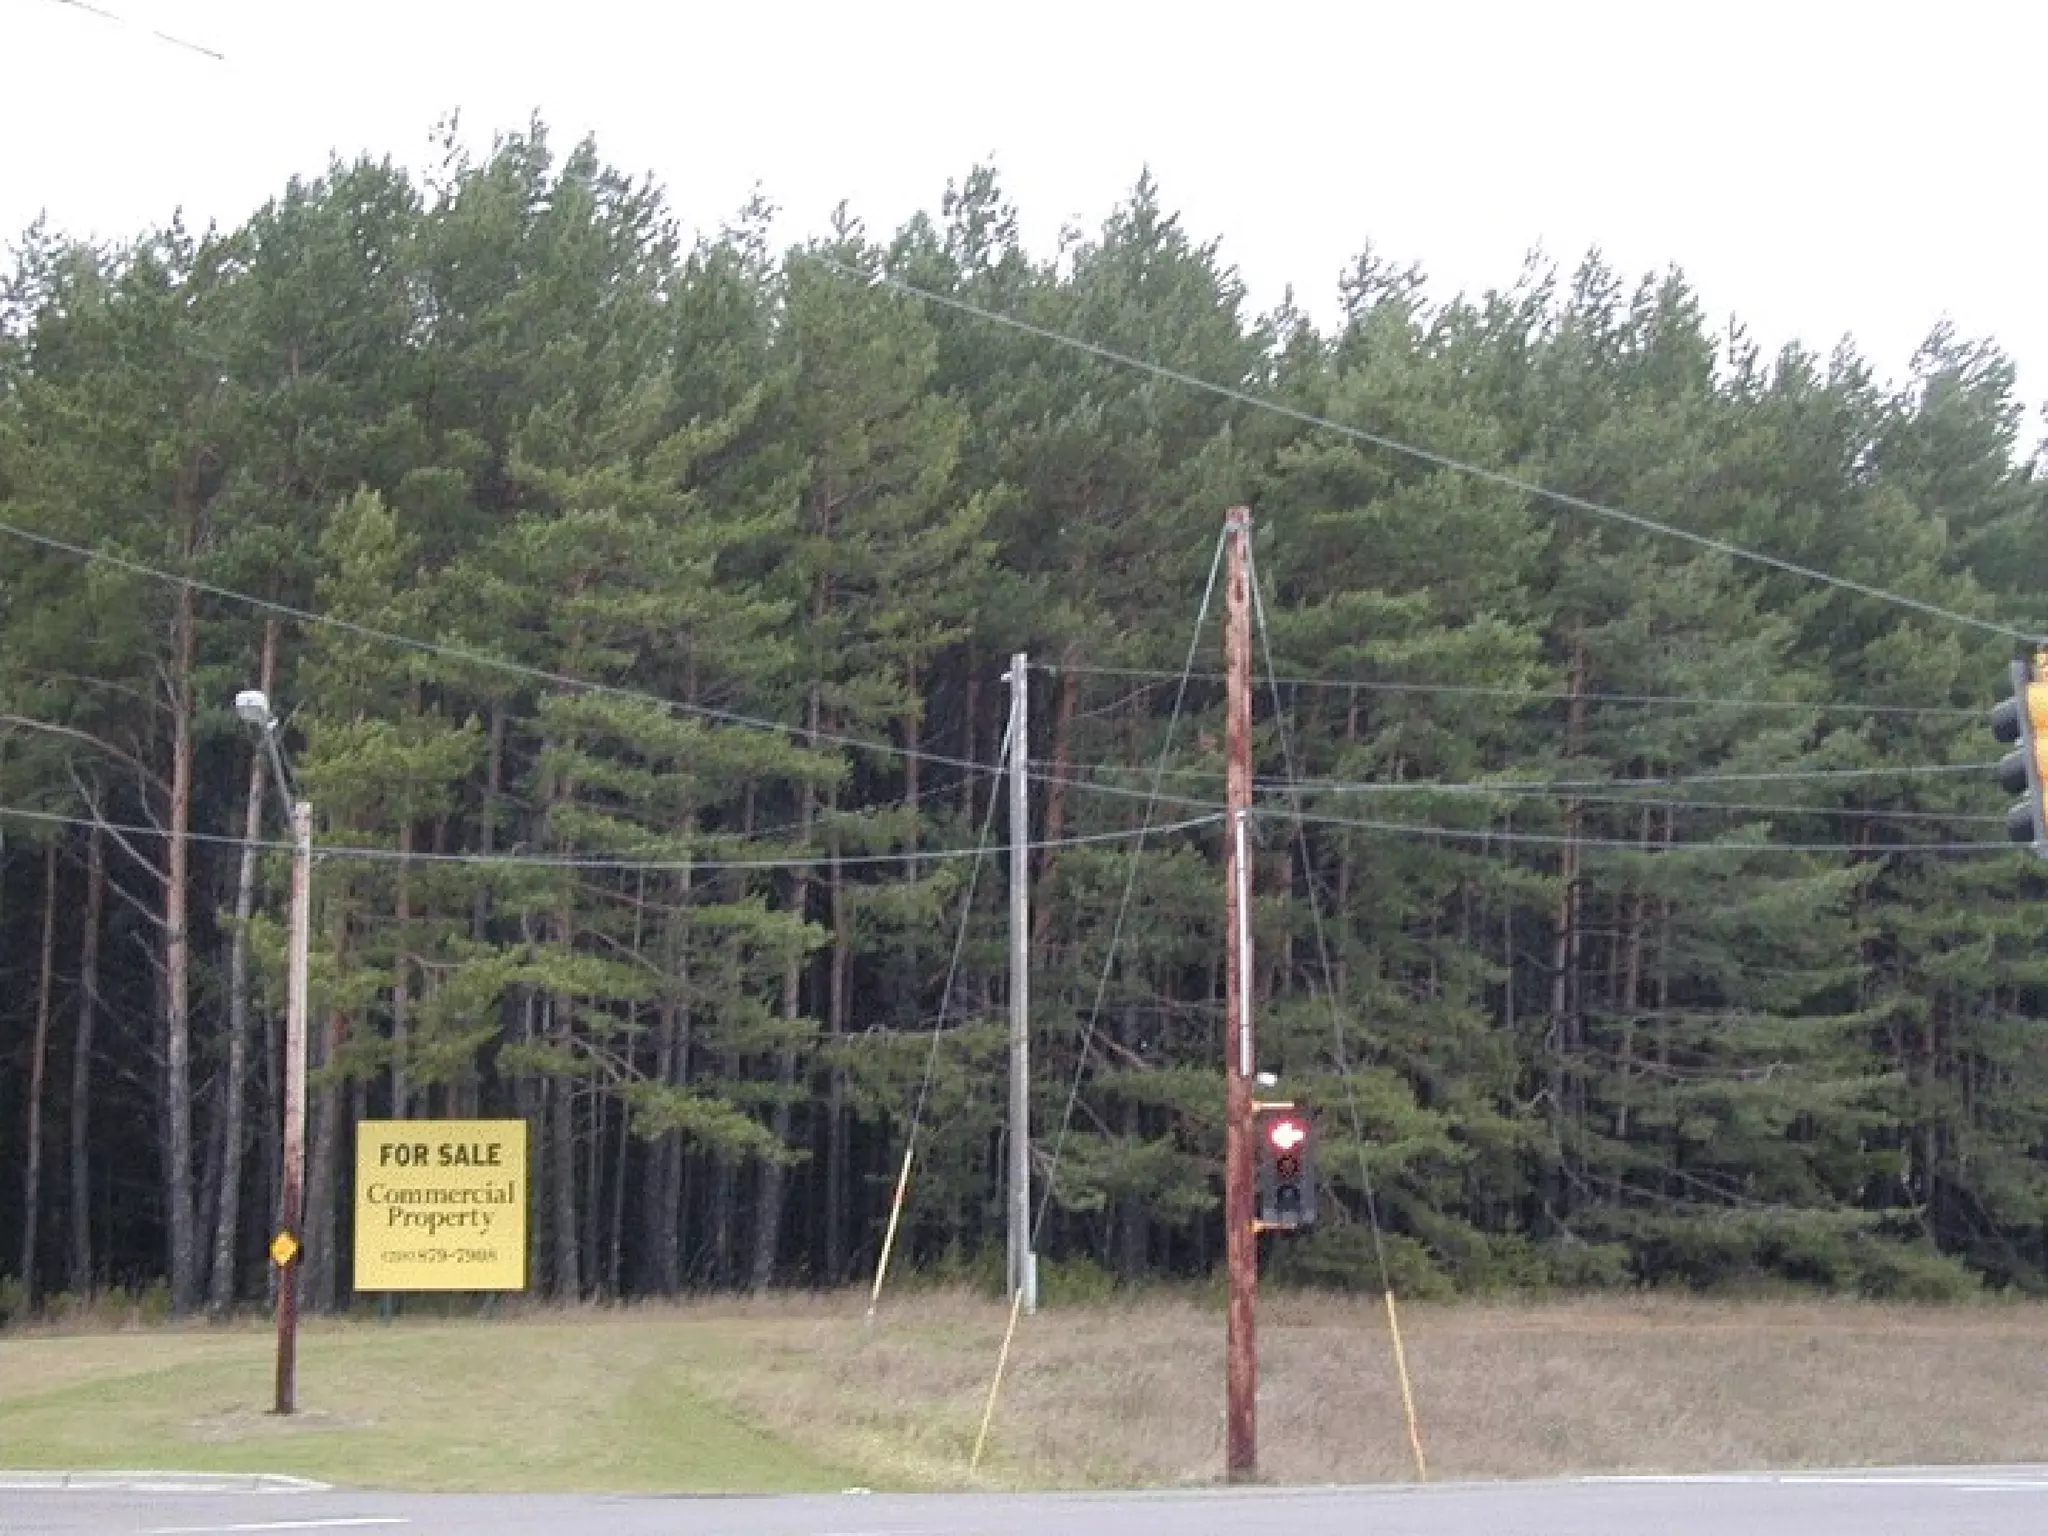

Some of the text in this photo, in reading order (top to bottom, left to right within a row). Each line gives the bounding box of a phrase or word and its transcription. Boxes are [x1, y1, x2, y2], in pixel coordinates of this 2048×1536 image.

[380, 1143, 502, 1167] FOR SALE
[367, 1180, 515, 1204] Commercial
[388, 1206, 495, 1236] Property
